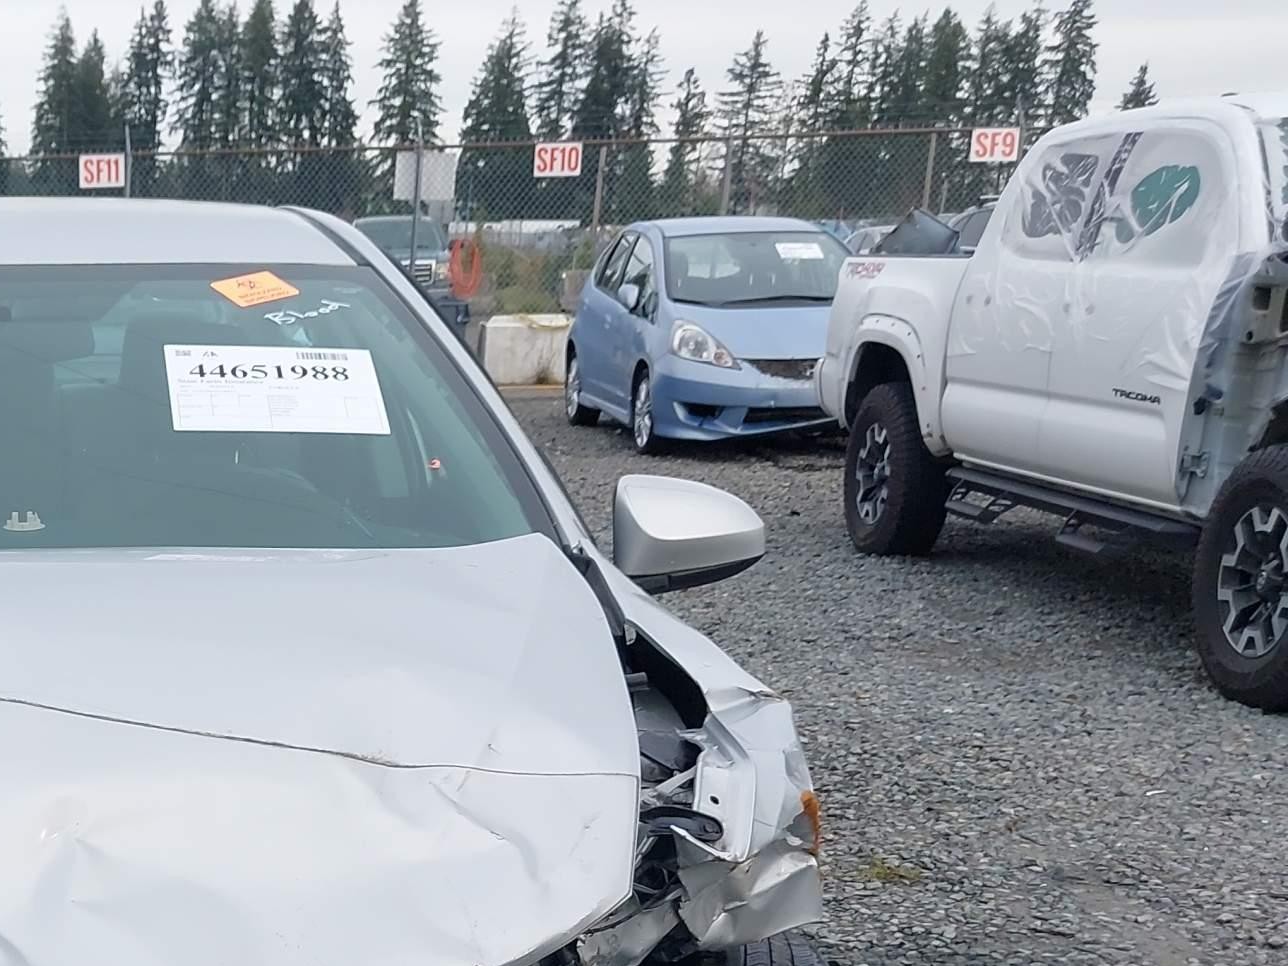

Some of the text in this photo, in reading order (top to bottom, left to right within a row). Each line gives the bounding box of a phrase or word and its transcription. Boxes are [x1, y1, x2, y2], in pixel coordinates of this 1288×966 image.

[975, 132, 1015, 157] SF9
[84, 158, 119, 184] SF11
[537, 146, 580, 172] SF10
[189, 363, 350, 381] 44651988
[1112, 387, 1161, 405] TACOMA
